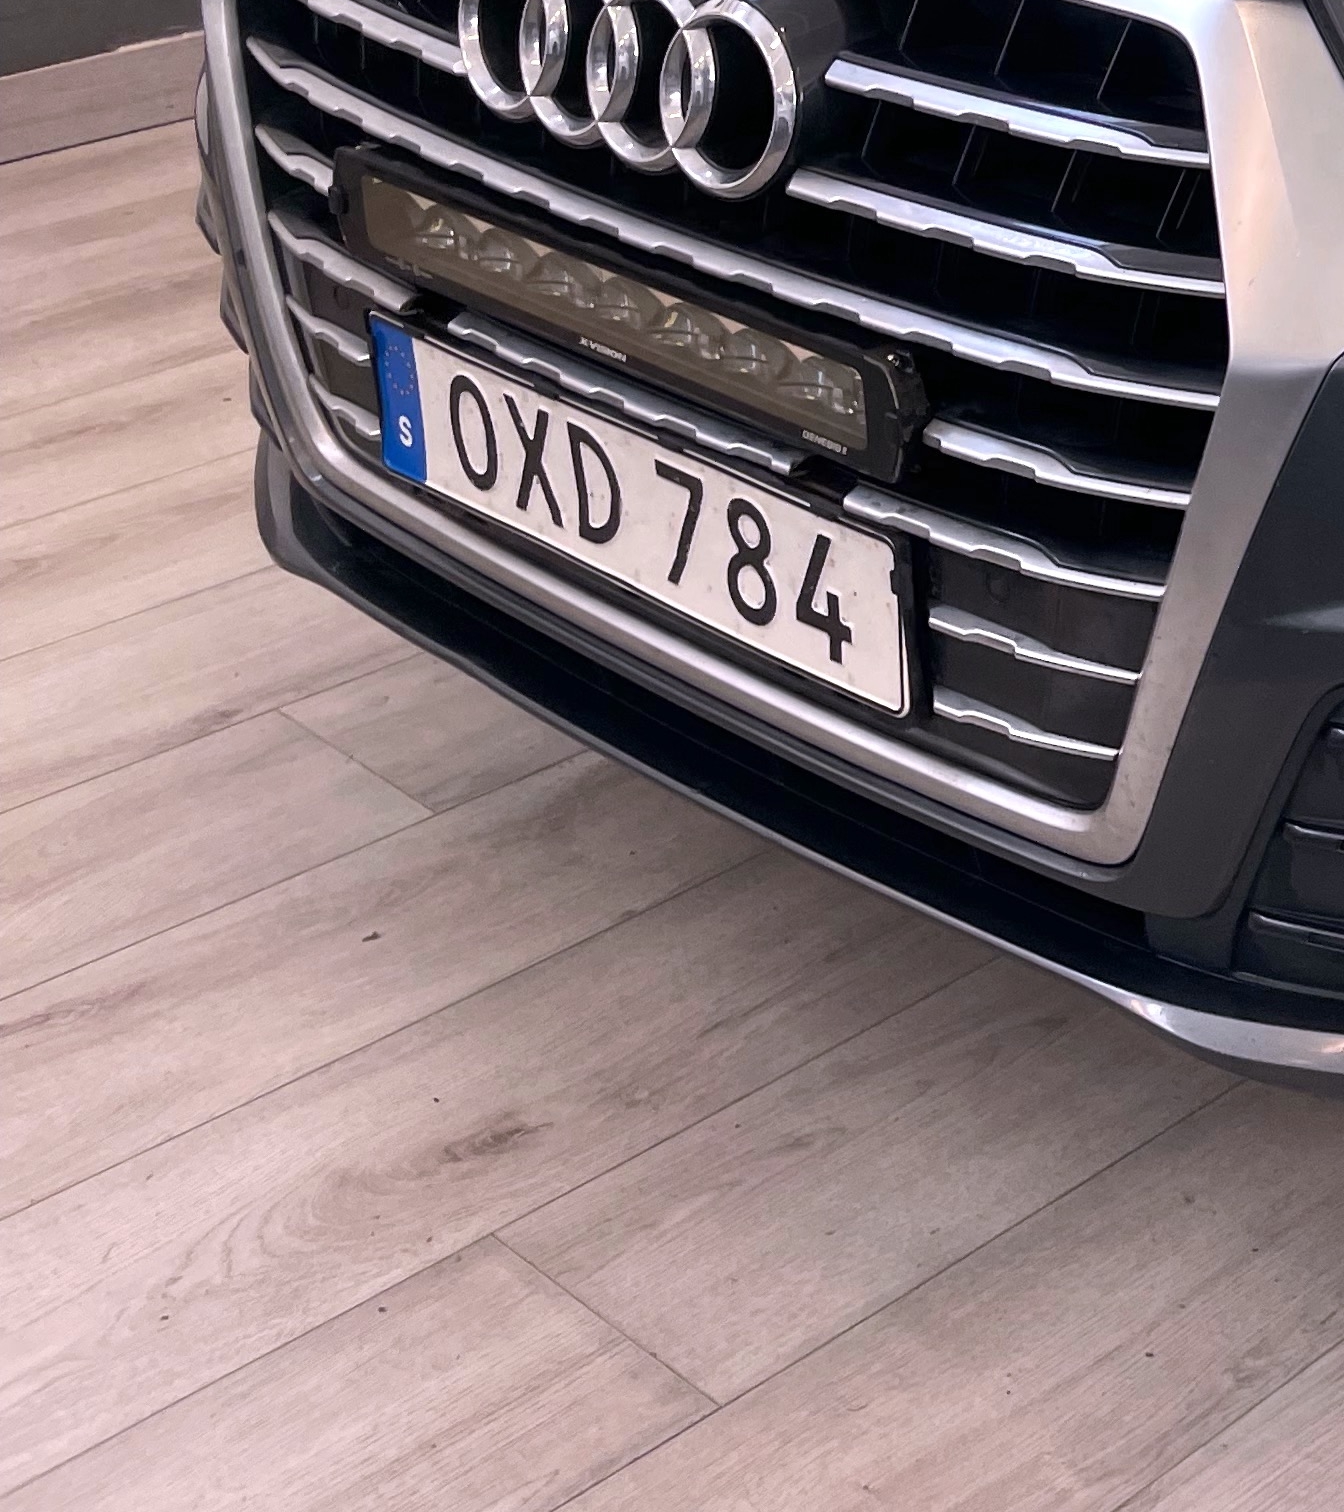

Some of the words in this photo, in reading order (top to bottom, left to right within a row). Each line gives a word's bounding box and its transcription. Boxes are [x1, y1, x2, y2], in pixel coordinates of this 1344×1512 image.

[397, 415, 414, 448] S
[448, 373, 623, 546] OXD
[654, 458, 856, 666] 784
